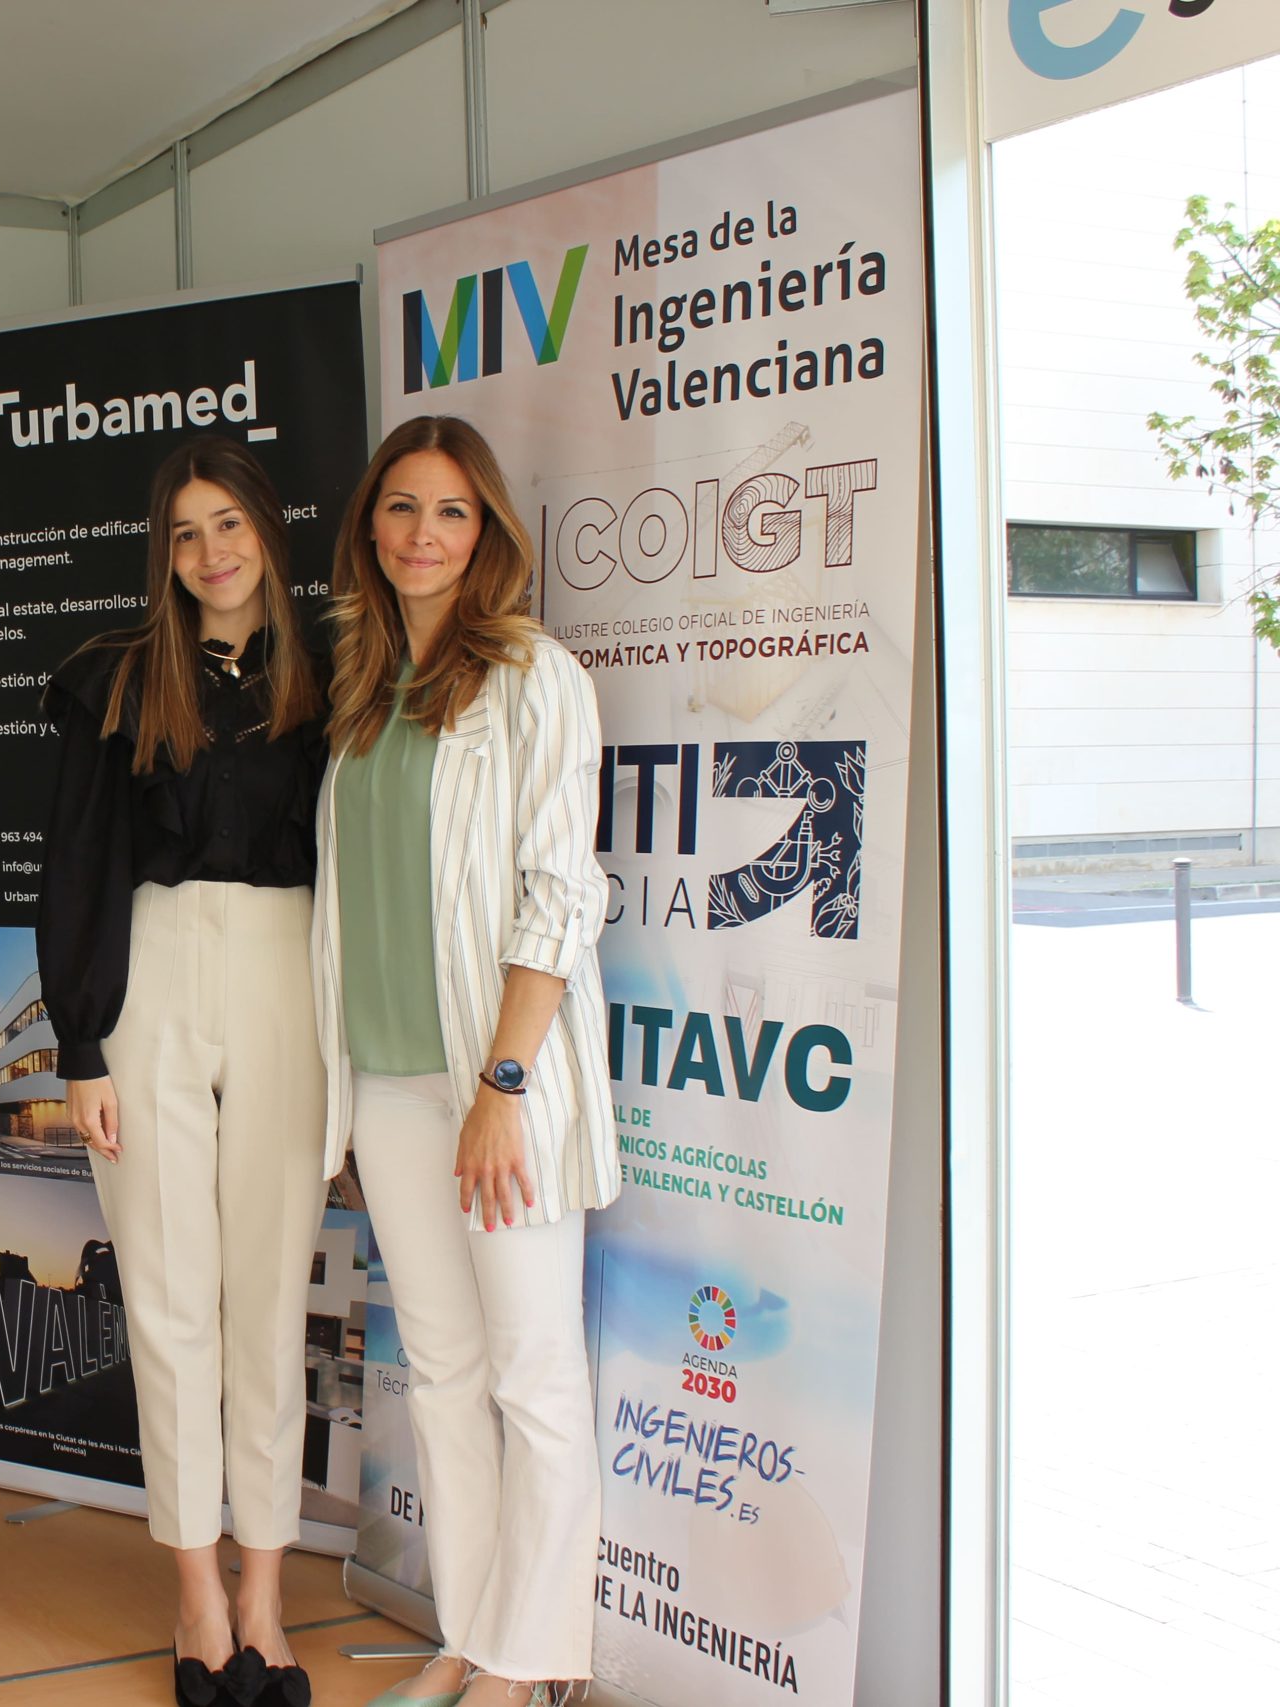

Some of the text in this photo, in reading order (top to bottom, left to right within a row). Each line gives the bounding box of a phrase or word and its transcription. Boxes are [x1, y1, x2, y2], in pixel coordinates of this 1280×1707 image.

[614, 201, 798, 276] Mesa de la
[613, 241, 887, 352] Ingeniería
[402, 244, 589, 395] MIV
[611, 334, 885, 421] Valenciana
[6, 360, 265, 447] urbamed
[70, 524, 88, 540] de
[91, 518, 150, 538] edificaci
[556, 458, 878, 591] COIGT
[13, 600, 58, 616] estate,
[60, 595, 137, 613] desarrollos
[308, 580, 329, 595] de
[554, 599, 871, 640] ILUSTRE COLEGIO OFICIAL DE INGENIERÍA
[676, 643, 690, 662] Y
[696, 629, 870, 662] TOPOGRÁFICA
[40, 722, 48, 737] y
[1, 832, 44, 843] 963 494
[2, 860, 43, 875] info@u
[631, 1107, 651, 1128] DE
[12, 1163, 42, 1172] servicios
[43, 1166, 70, 1175] sociales
[617, 1133, 767, 1180] NICOS AGRÍCOLAS
[632, 1166, 712, 1201] VALENCIA
[718, 1183, 730, 1203] Y
[734, 1186, 844, 1226] CASTELLÓN
[682, 1352, 738, 1379] AGENDA
[682, 1369, 737, 1403] 2030
[4, 1423, 38, 1437] corpóreas
[48, 1431, 55, 1440] la
[56, 1433, 77, 1445] Ciutat
[77, 1438, 88, 1446] de
[99, 1442, 114, 1451] Arts
[52, 1443, 87, 1457] (Valencia)
[390, 1485, 413, 1522] DE
[619, 1583, 647, 1627] LA
[655, 1599, 798, 1694] INGENIERÍA
